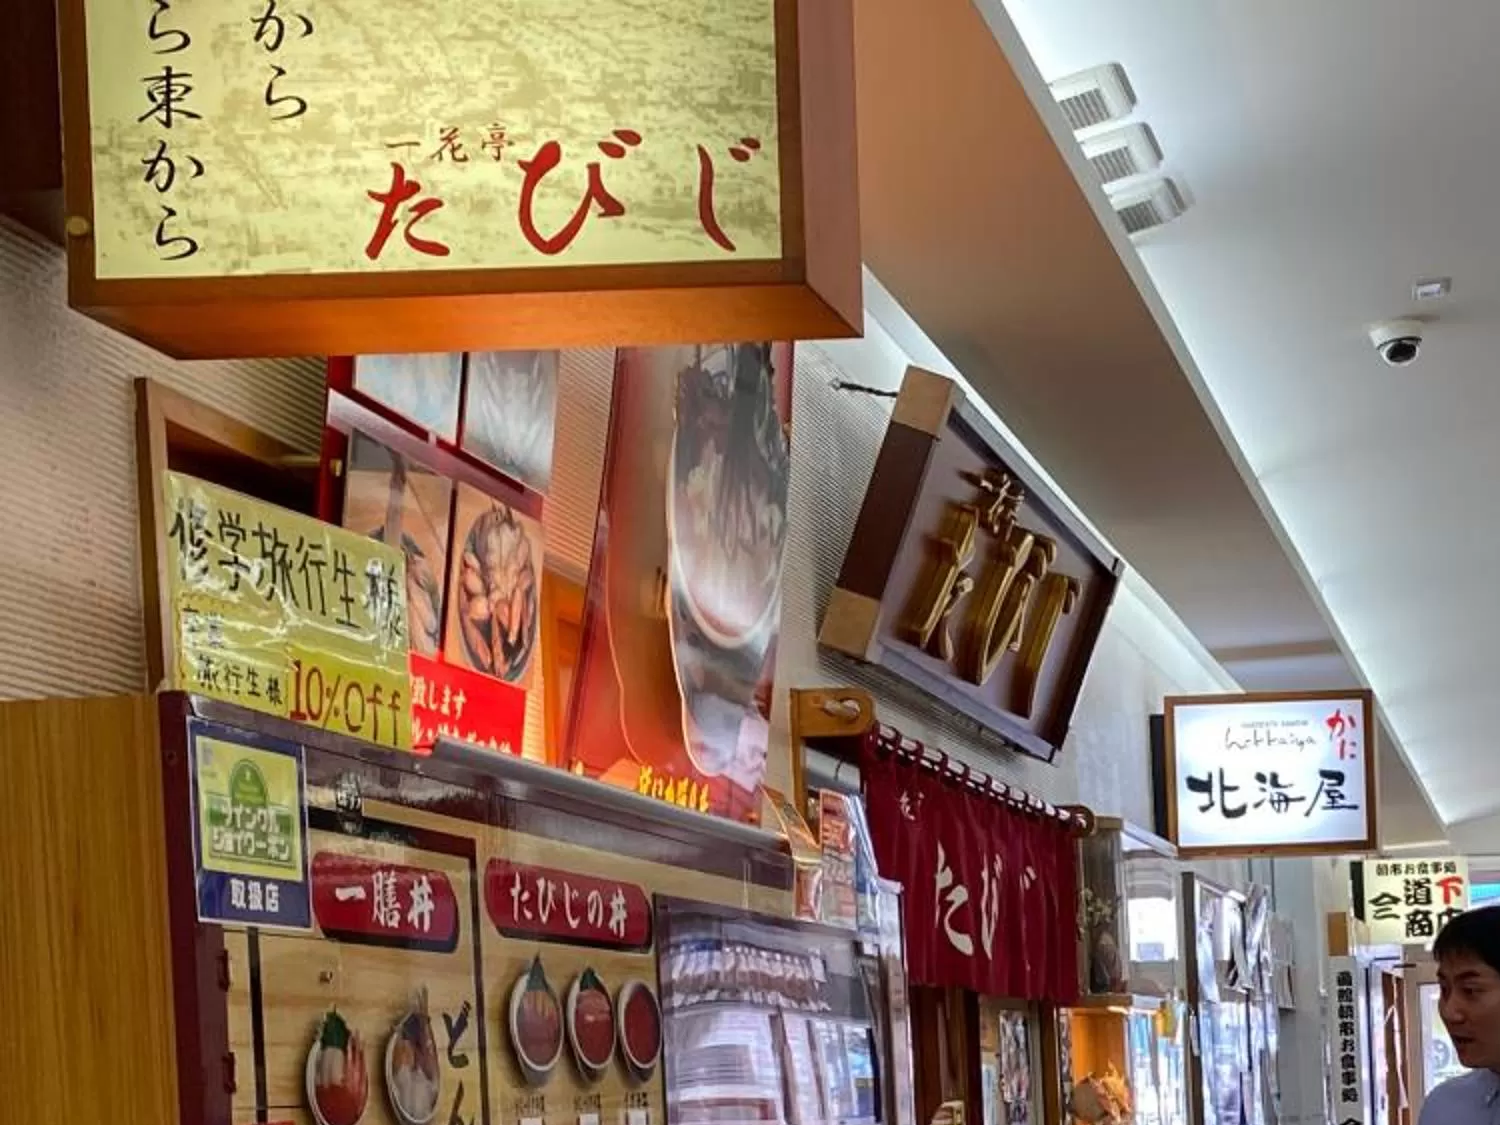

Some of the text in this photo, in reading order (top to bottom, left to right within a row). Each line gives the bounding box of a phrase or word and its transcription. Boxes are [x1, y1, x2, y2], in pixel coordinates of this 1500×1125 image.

[386, 122, 515, 164] 一花亭
[365, 128, 762, 262] たびじ
[1186, 768, 1359, 819] 北海屋
[231, 878, 280, 912] 取扱店
[510, 872, 628, 939] たびじの丼
